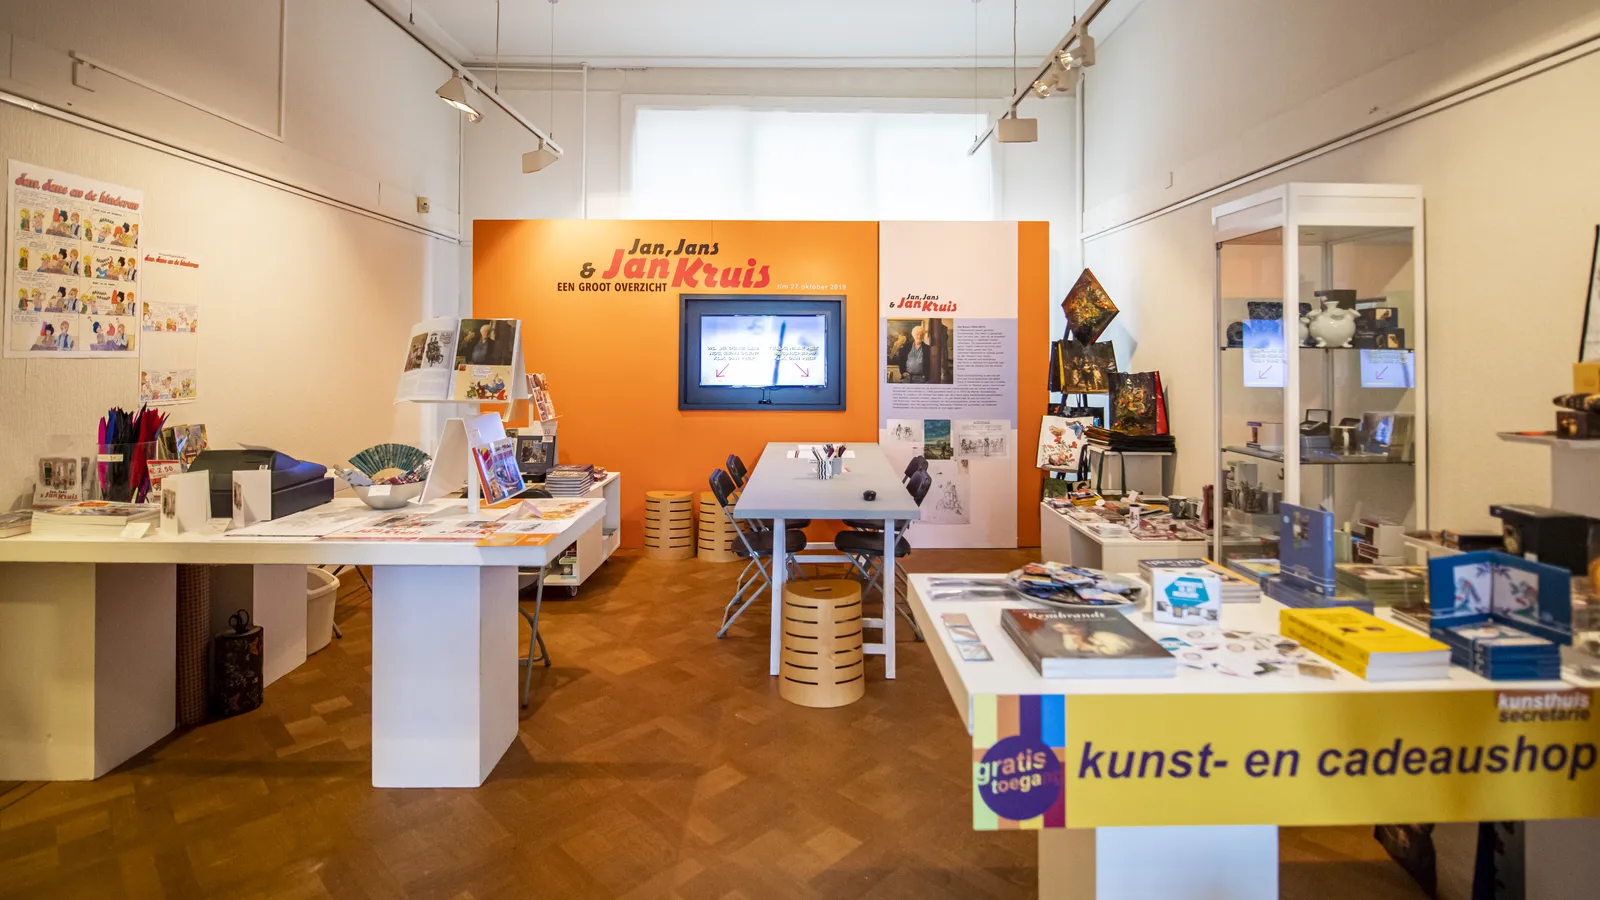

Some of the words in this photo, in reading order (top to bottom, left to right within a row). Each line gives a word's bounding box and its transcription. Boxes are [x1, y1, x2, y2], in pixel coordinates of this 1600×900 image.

[629, 238, 670, 257] Jan,
[673, 238, 719, 255] Jans
[579, 262, 596, 279] &
[602, 249, 670, 280] Jan
[671, 257, 770, 289] Kruis
[557, 282, 575, 292] EEN
[578, 282, 610, 292] GROOT
[614, 282, 667, 292] OVERZICHT
[897, 297, 921, 309] Jan
[921, 300, 957, 312] Kruis
[1027, 611, 1105, 620] Rembrandt
[1498, 692, 1590, 709] kunsthuis
[1498, 709, 1591, 723] secretarie
[1077, 741, 1229, 780] kunst-
[1244, 747, 1300, 779] en
[1316, 735, 1598, 781] cadeaushop
[976, 748, 1047, 786] gratis
